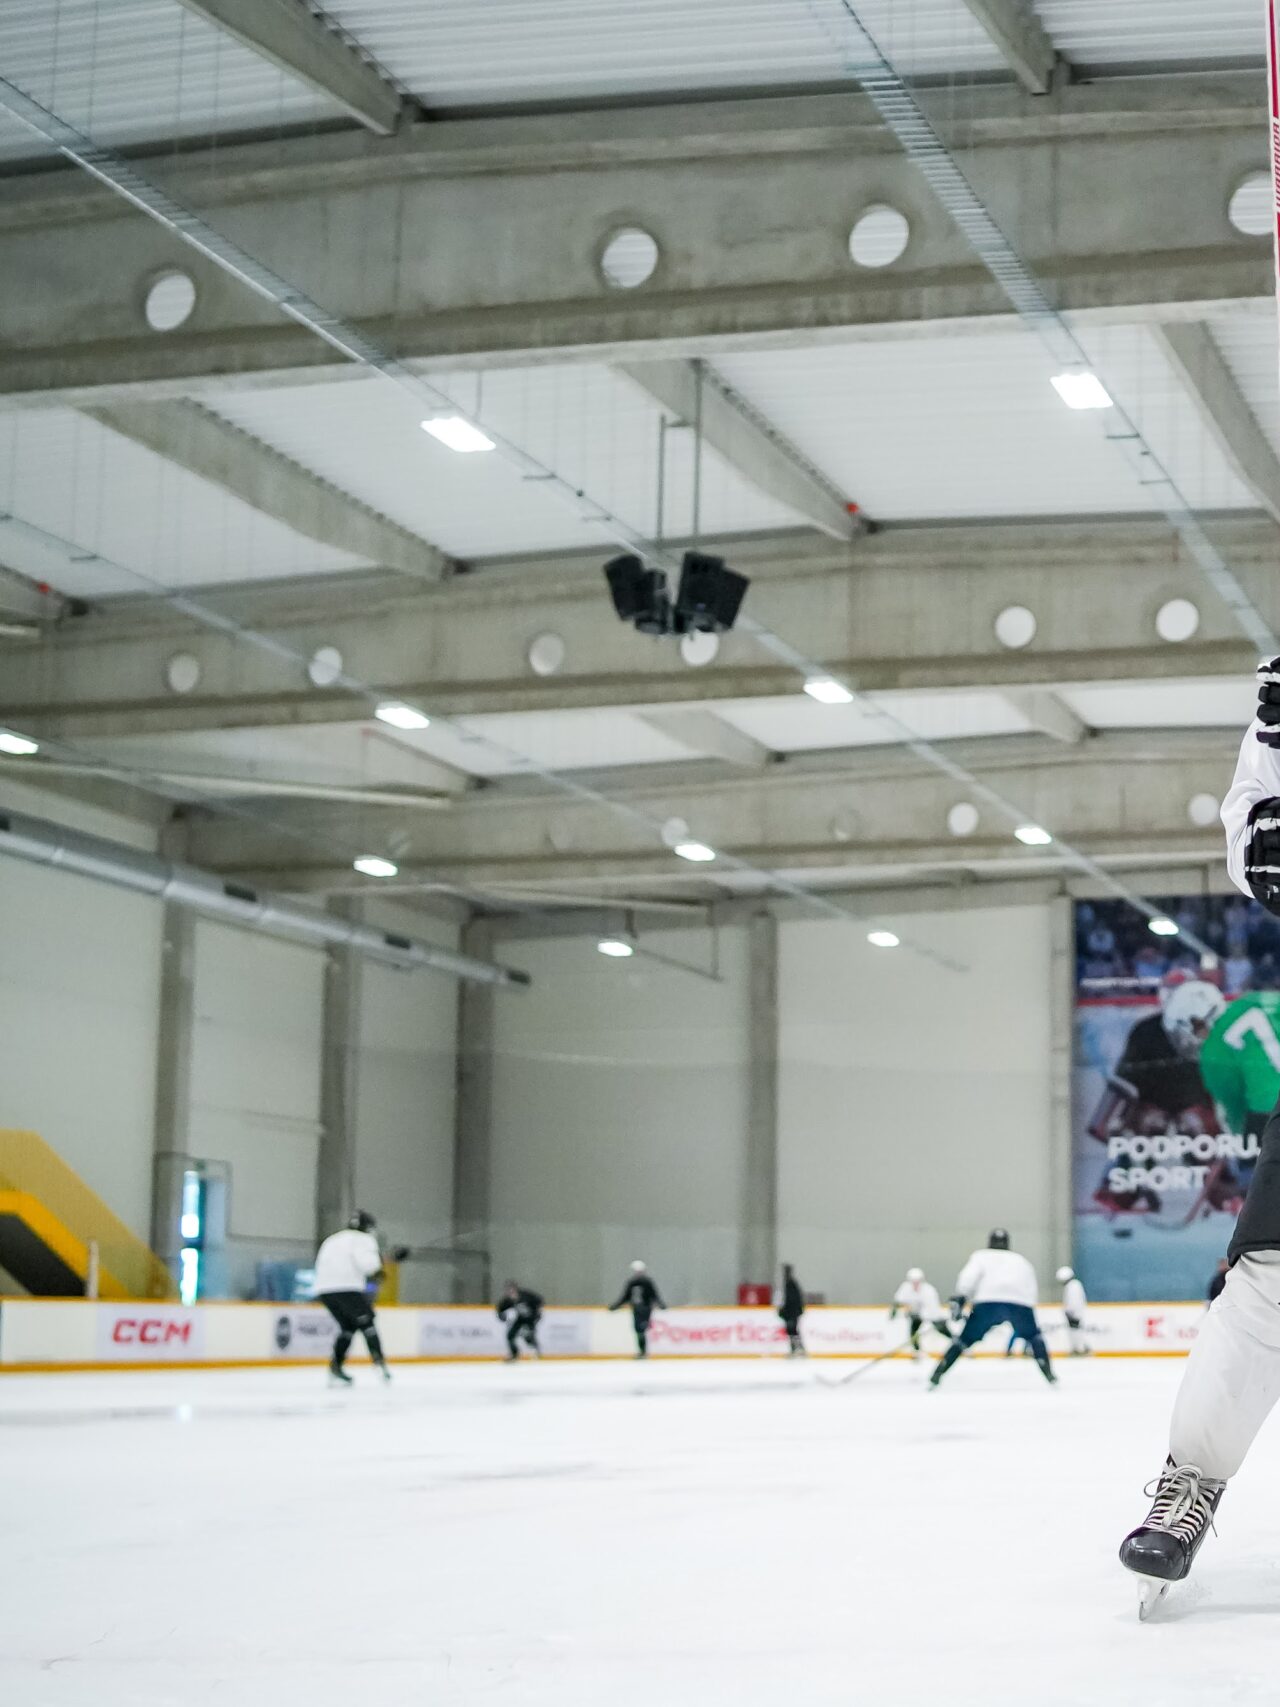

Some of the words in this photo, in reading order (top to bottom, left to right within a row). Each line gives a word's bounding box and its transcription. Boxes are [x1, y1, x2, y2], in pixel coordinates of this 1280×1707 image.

[1107, 1132, 1261, 1161] PODPORU
[1107, 1165, 1211, 1194] SPORT
[112, 1318, 191, 1344] CCM
